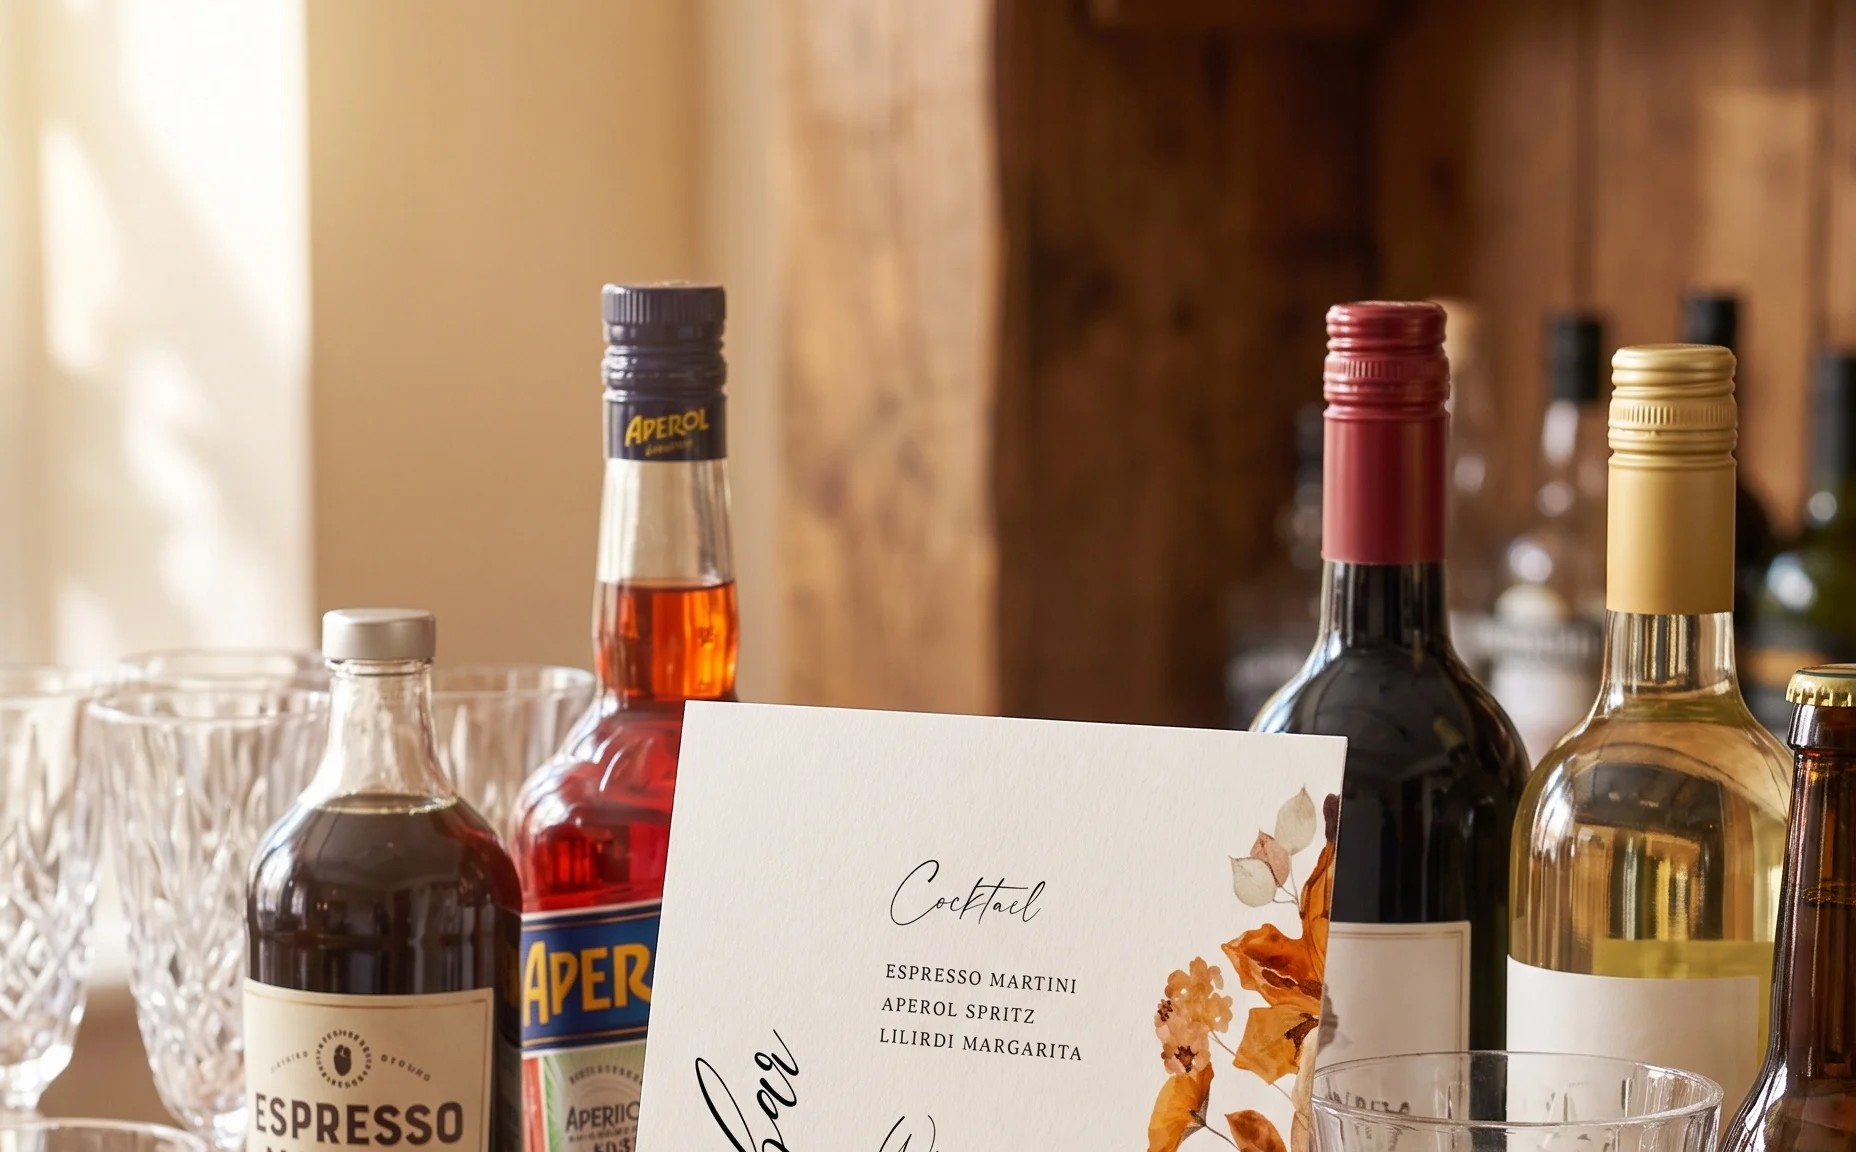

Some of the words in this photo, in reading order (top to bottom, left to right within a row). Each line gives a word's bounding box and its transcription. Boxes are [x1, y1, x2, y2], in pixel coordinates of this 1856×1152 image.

[624, 408, 710, 448] APEROL
[522, 940, 653, 1028] APER
[885, 963, 982, 986] ESPRESSO
[989, 972, 1077, 994] MARTINI
[881, 997, 958, 1017] APEROL
[965, 1003, 1035, 1024] SPRITZ
[879, 1027, 954, 1049] LILIRDI
[962, 1035, 1082, 1061] MARGARITA
[255, 1092, 464, 1147] ESPRESSO
